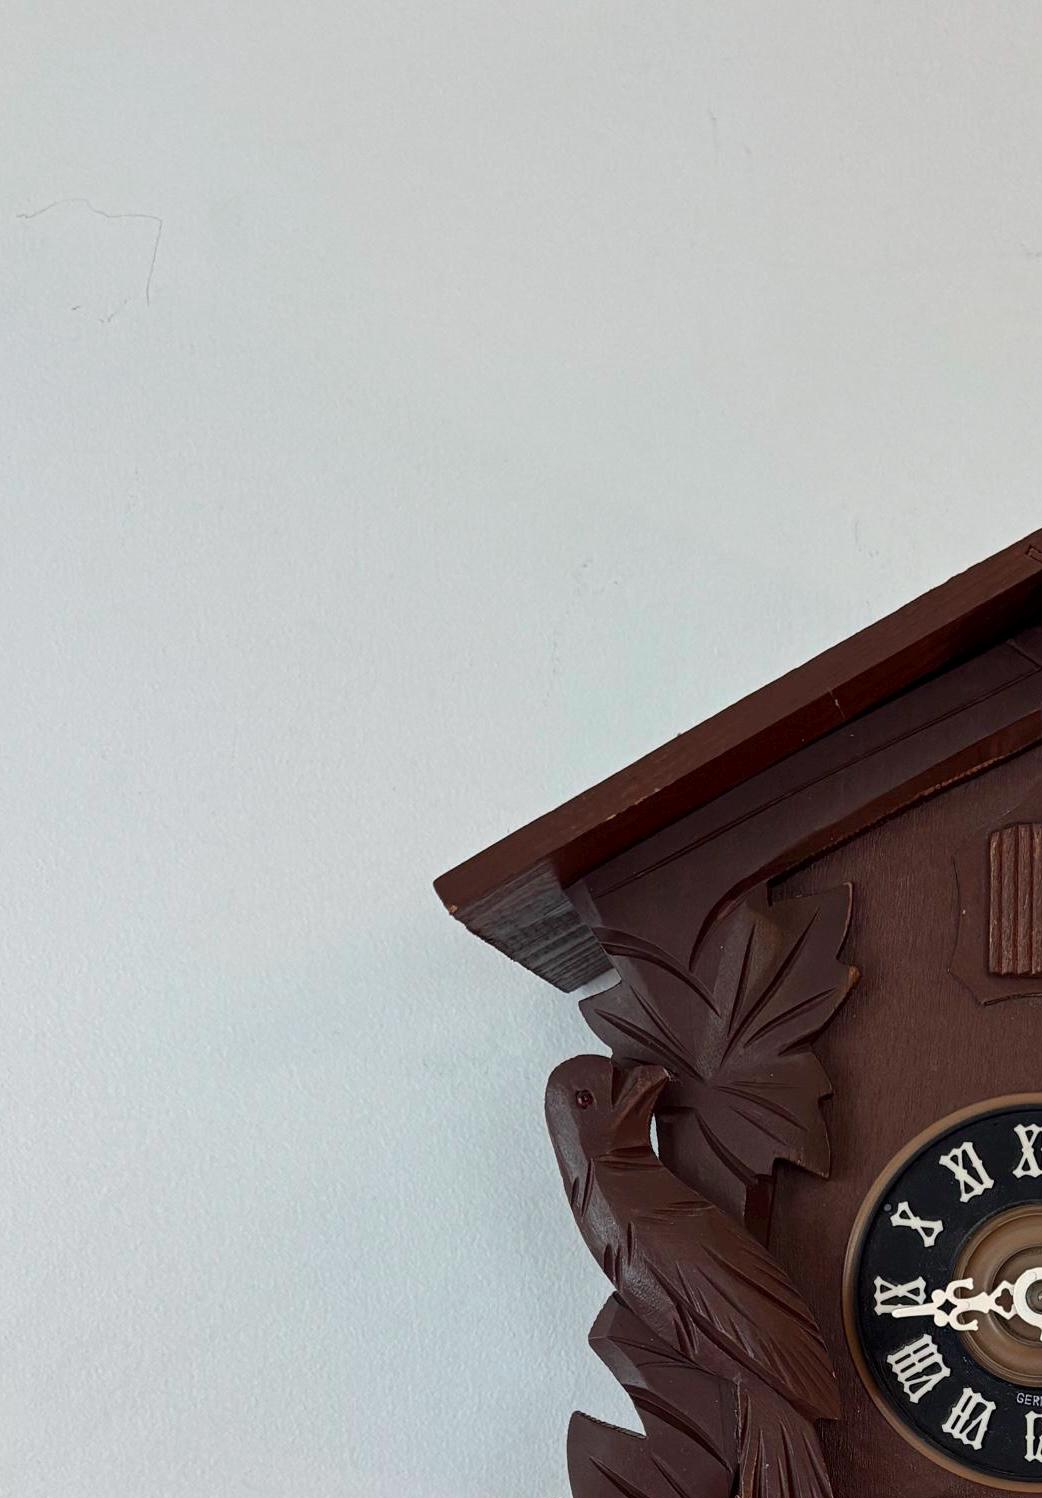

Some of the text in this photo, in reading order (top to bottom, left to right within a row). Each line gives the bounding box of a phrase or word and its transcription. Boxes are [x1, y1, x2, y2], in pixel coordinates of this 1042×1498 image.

[939, 1142, 994, 1202] XI
[890, 1202, 943, 1247] X
[887, 1334, 951, 1403] VIII
[942, 1387, 996, 1450] VII
